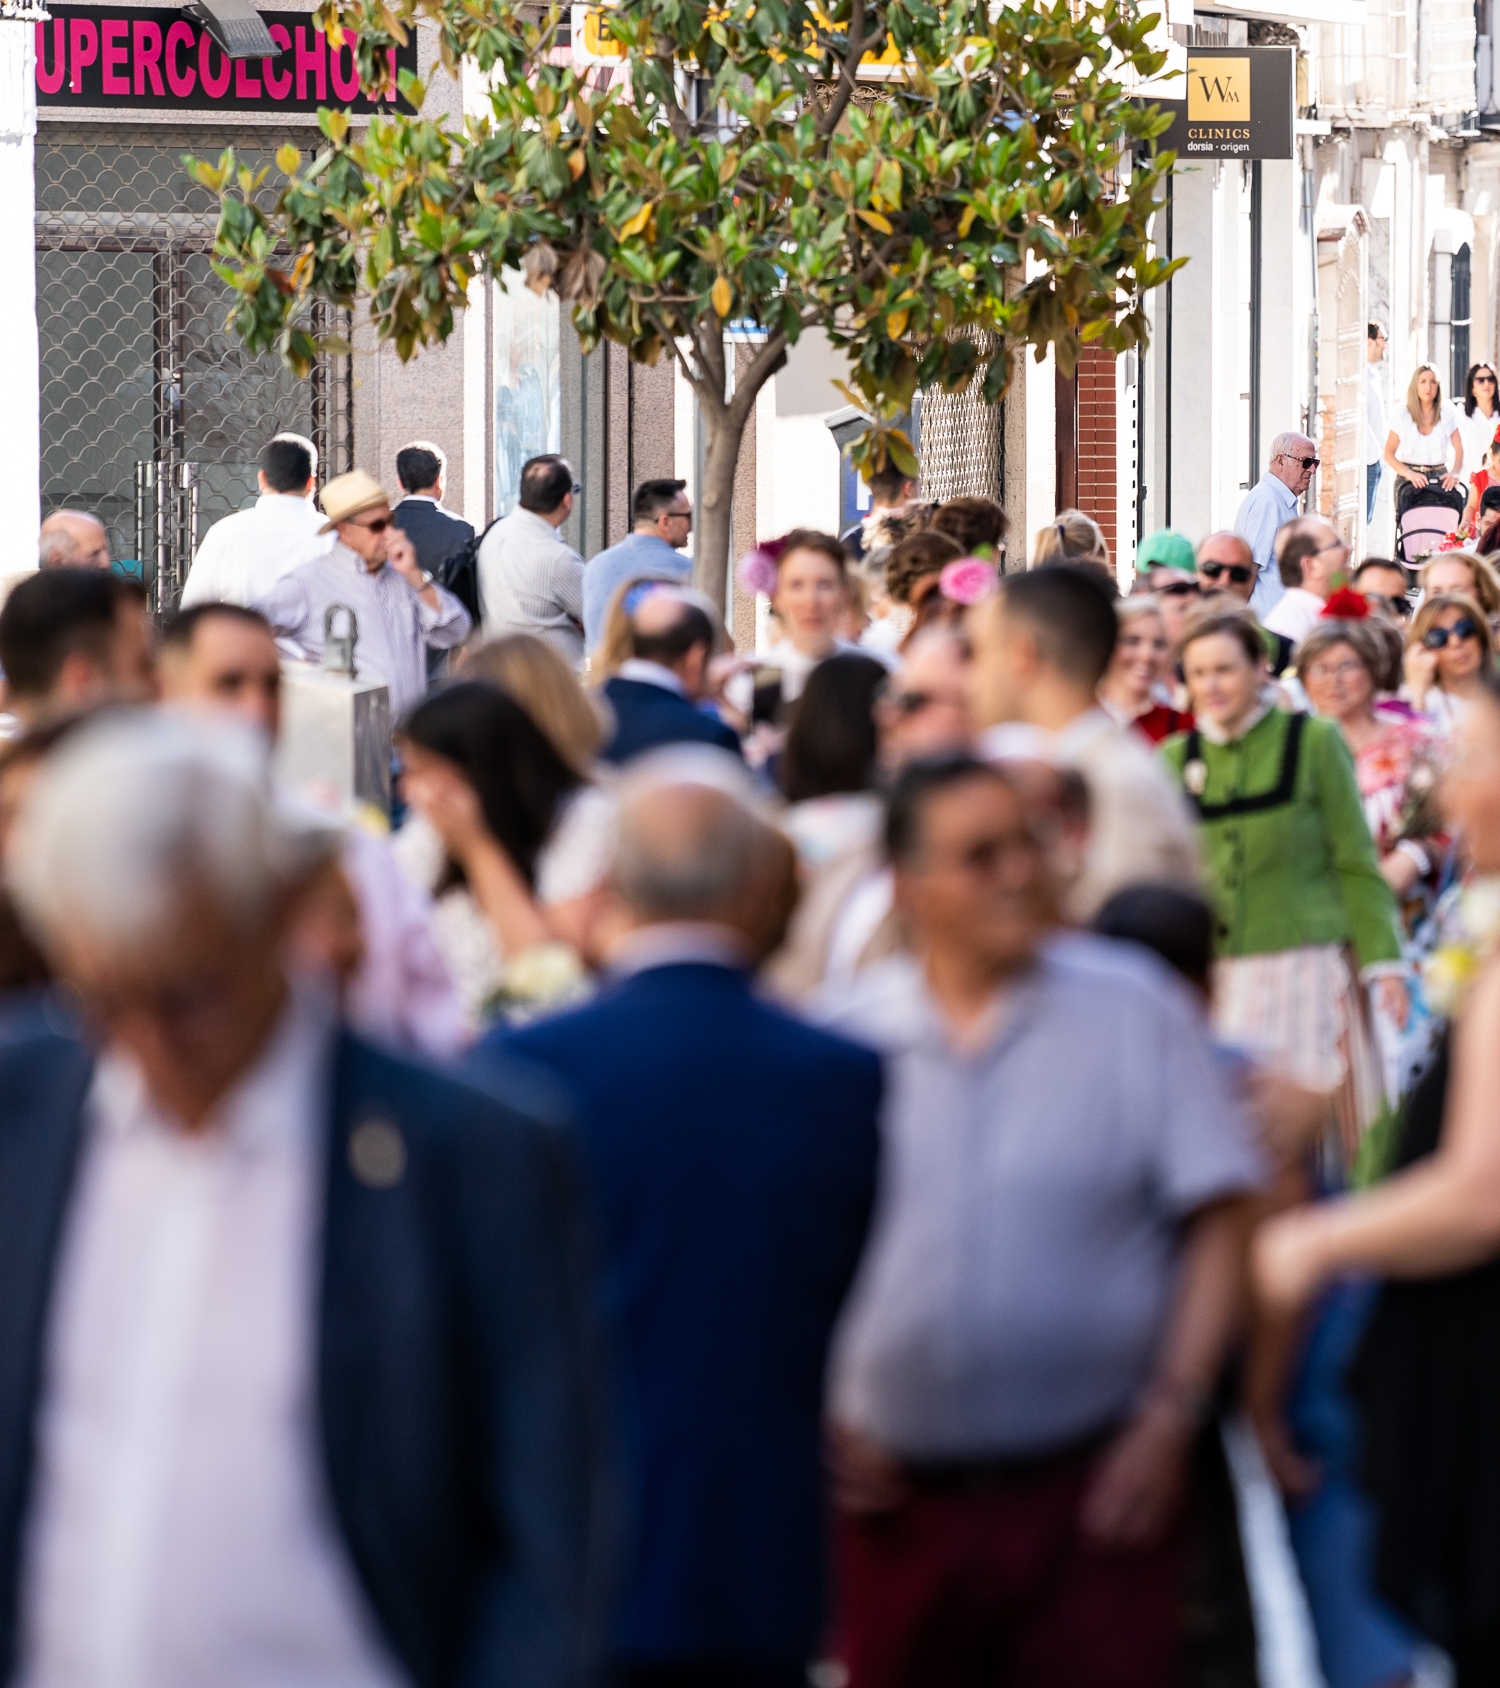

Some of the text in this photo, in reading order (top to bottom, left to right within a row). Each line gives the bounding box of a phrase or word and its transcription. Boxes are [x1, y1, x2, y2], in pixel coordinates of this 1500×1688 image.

[1188, 128, 1250, 139] CLINICS
[1187, 141, 1250, 153] dorsia origen
